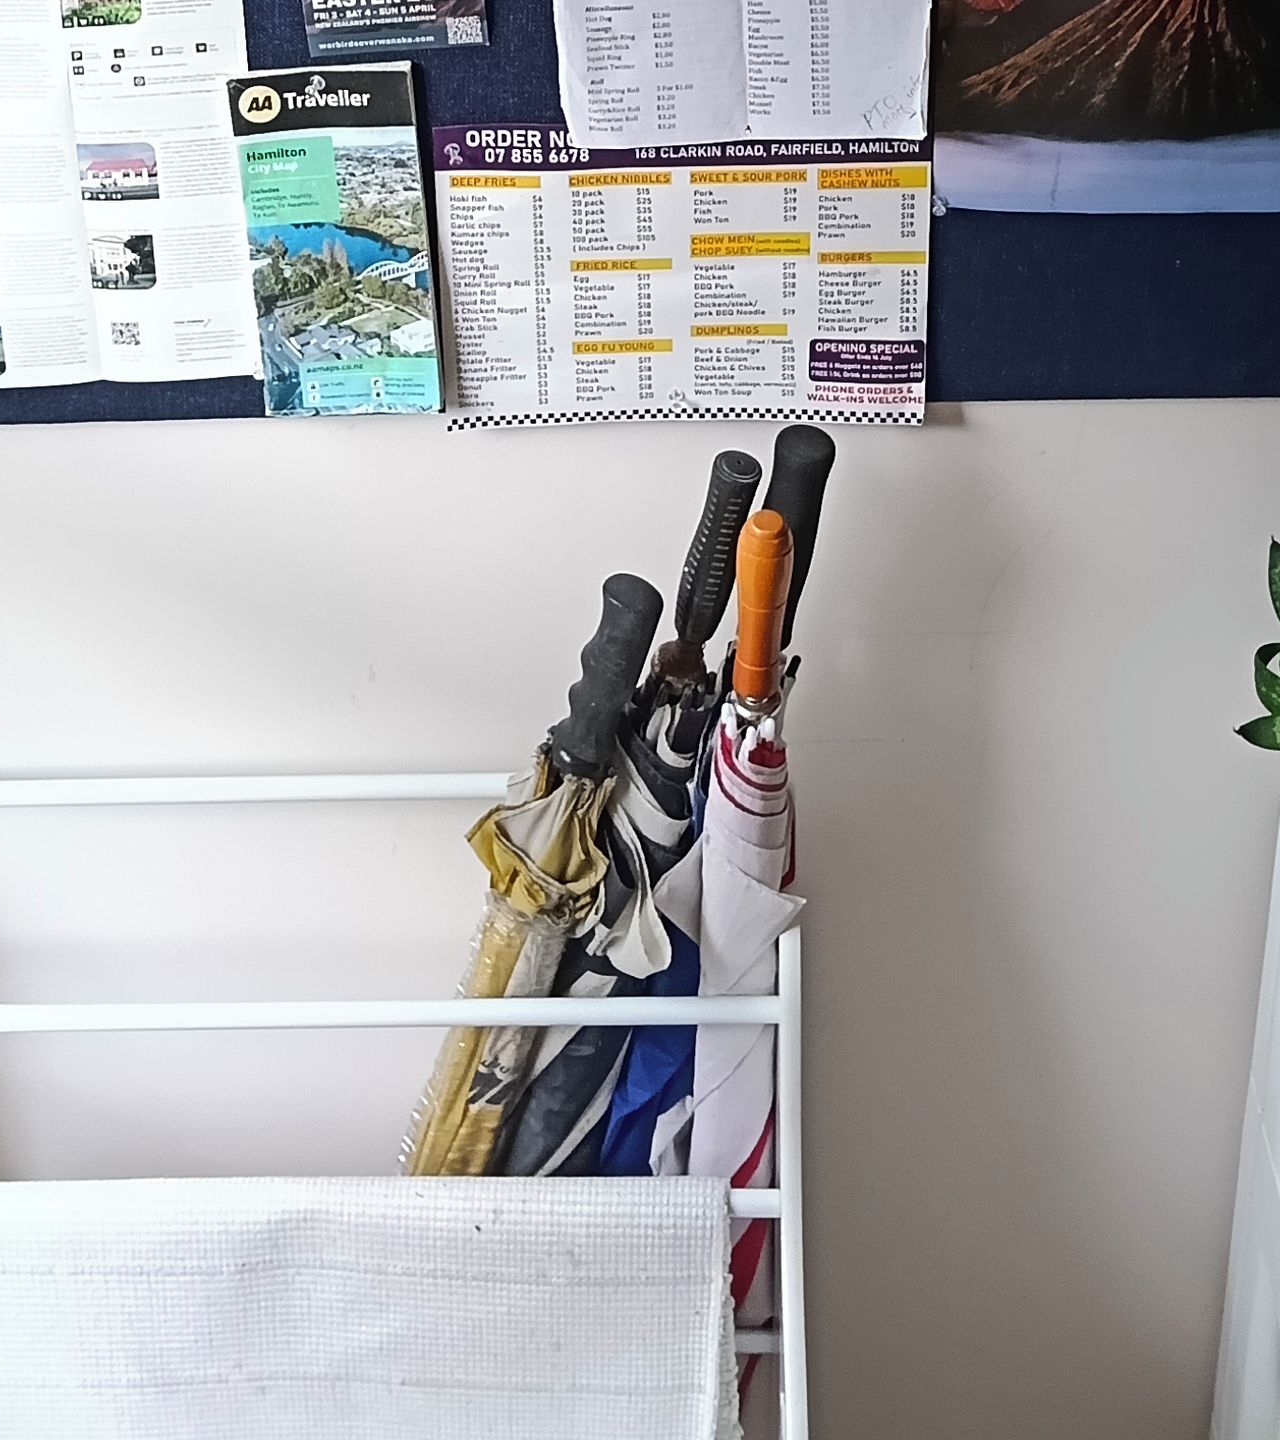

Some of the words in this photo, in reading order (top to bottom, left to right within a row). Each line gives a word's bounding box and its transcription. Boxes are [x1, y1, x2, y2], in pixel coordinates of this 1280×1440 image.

[319, 35, 434, 49] warbirdsoverwanaka.com
[248, 96, 273, 112] AA
[283, 91, 370, 110] Traveller
[466, 131, 542, 147] ORDER
[246, 147, 306, 162] Hamilton
[485, 150, 507, 163] 07
[511, 149, 543, 163] 855
[549, 148, 590, 162] 6678
[634, 147, 657, 159] 168
[660, 146, 721, 158] CLARKIN
[725, 144, 768, 159] ROAD,
[771, 143, 846, 157] FAIRFIELD,
[849, 142, 919, 154] HAMILTON
[452, 178, 480, 187] DEEP
[484, 177, 516, 186] FRIES
[570, 176, 618, 186] CHICKEN
[622, 174, 671, 184] NIBBLES
[691, 173, 729, 183] SWEET
[732, 173, 739, 181] &
[743, 172, 773, 182] SOUR
[776, 171, 807, 181] PORK
[821, 253, 872, 262] BURGERS
[696, 326, 759, 335] DUMPLINGS
[815, 343, 866, 353] OPENING
[870, 344, 918, 353] SPECIAL
